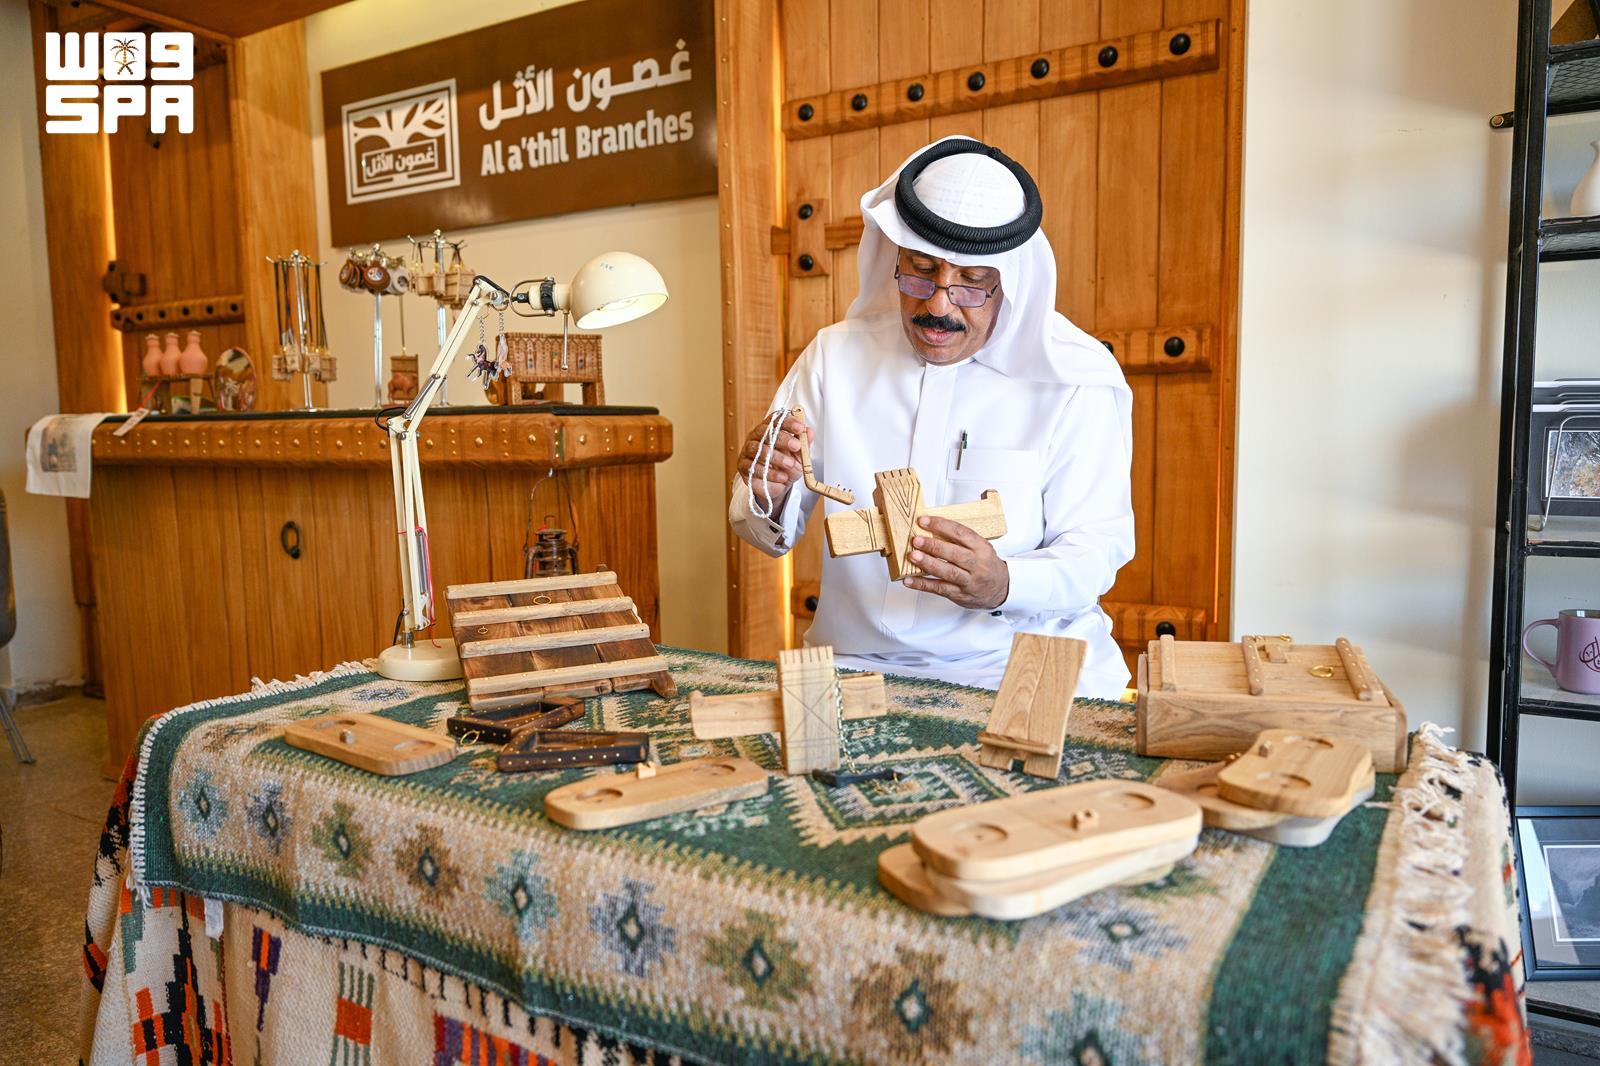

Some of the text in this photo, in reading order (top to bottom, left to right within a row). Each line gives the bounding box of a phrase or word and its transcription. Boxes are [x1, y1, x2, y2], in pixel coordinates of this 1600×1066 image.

[479, 38, 692, 131] غصون الأثل
[395, 146, 434, 172] غصون
[576, 109, 693, 159] Branches
